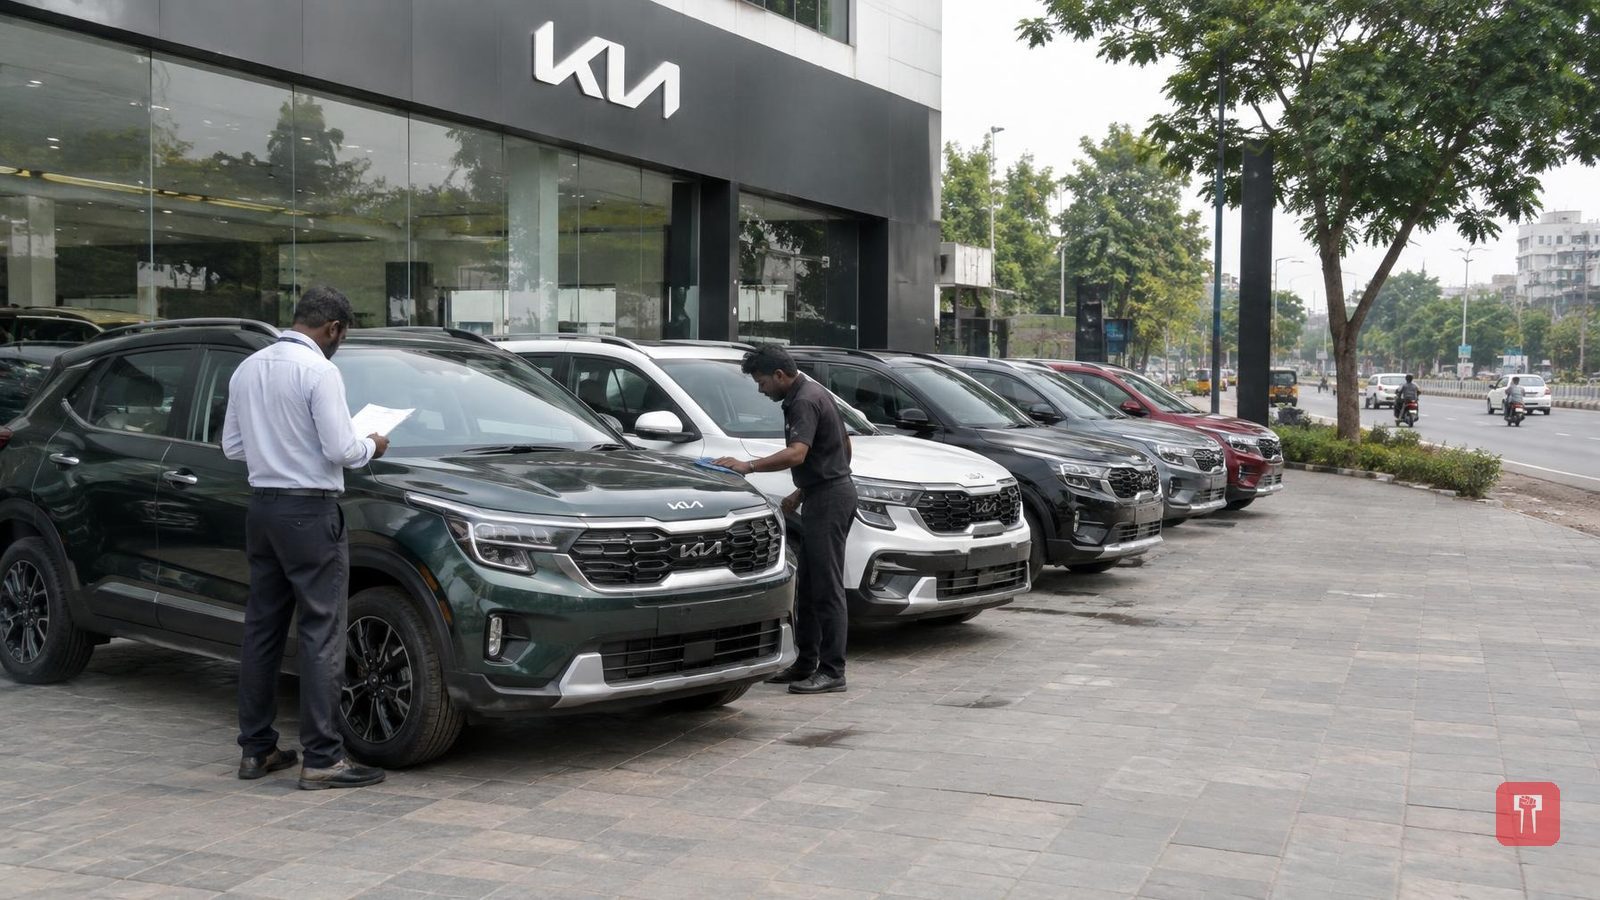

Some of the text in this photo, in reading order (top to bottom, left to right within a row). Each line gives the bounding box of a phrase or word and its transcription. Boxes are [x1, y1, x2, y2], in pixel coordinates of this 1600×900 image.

[533, 20, 680, 119] KIA
[667, 500, 704, 510] KIA
[680, 541, 722, 558] KIA
